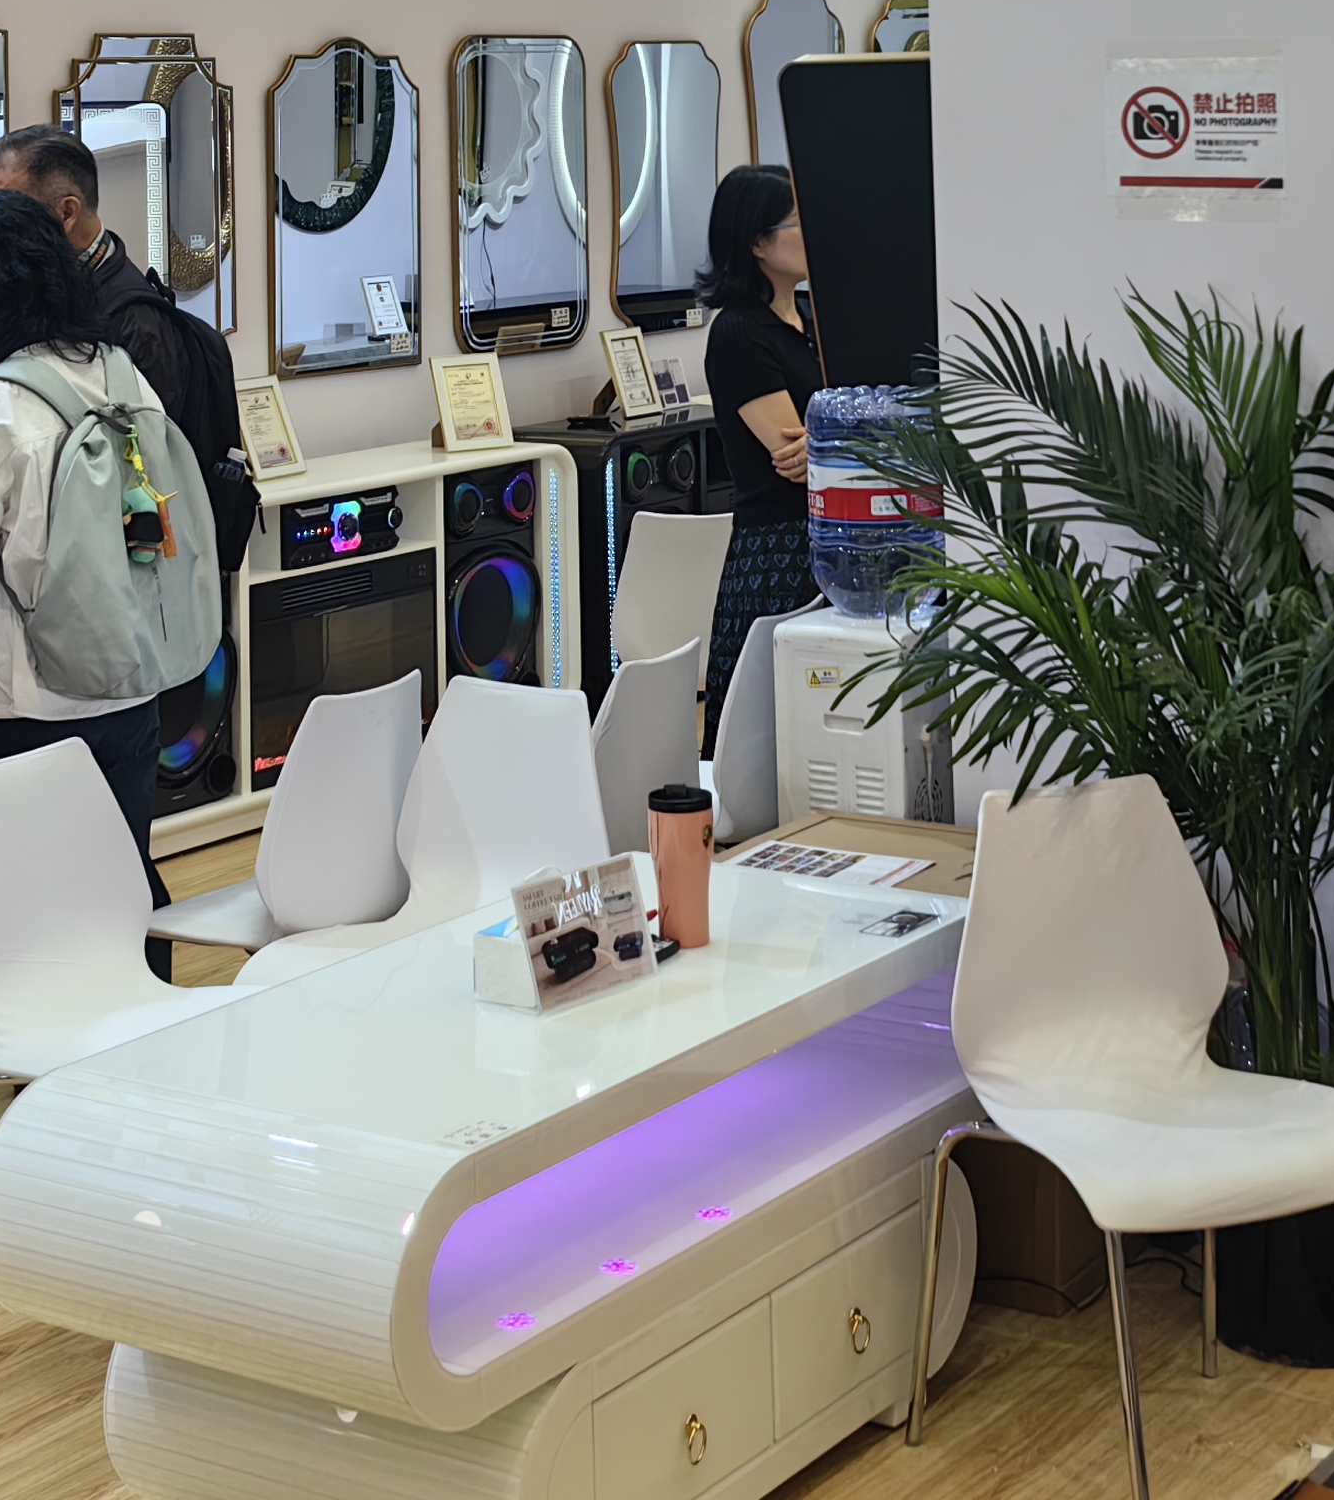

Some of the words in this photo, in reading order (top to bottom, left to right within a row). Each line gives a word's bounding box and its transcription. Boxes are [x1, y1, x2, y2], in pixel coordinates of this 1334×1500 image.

[1193, 92, 1277, 114] 禁止拍照
[1194, 117, 1208, 127] NO
[1209, 117, 1278, 127] PHOTOGRAPHY
